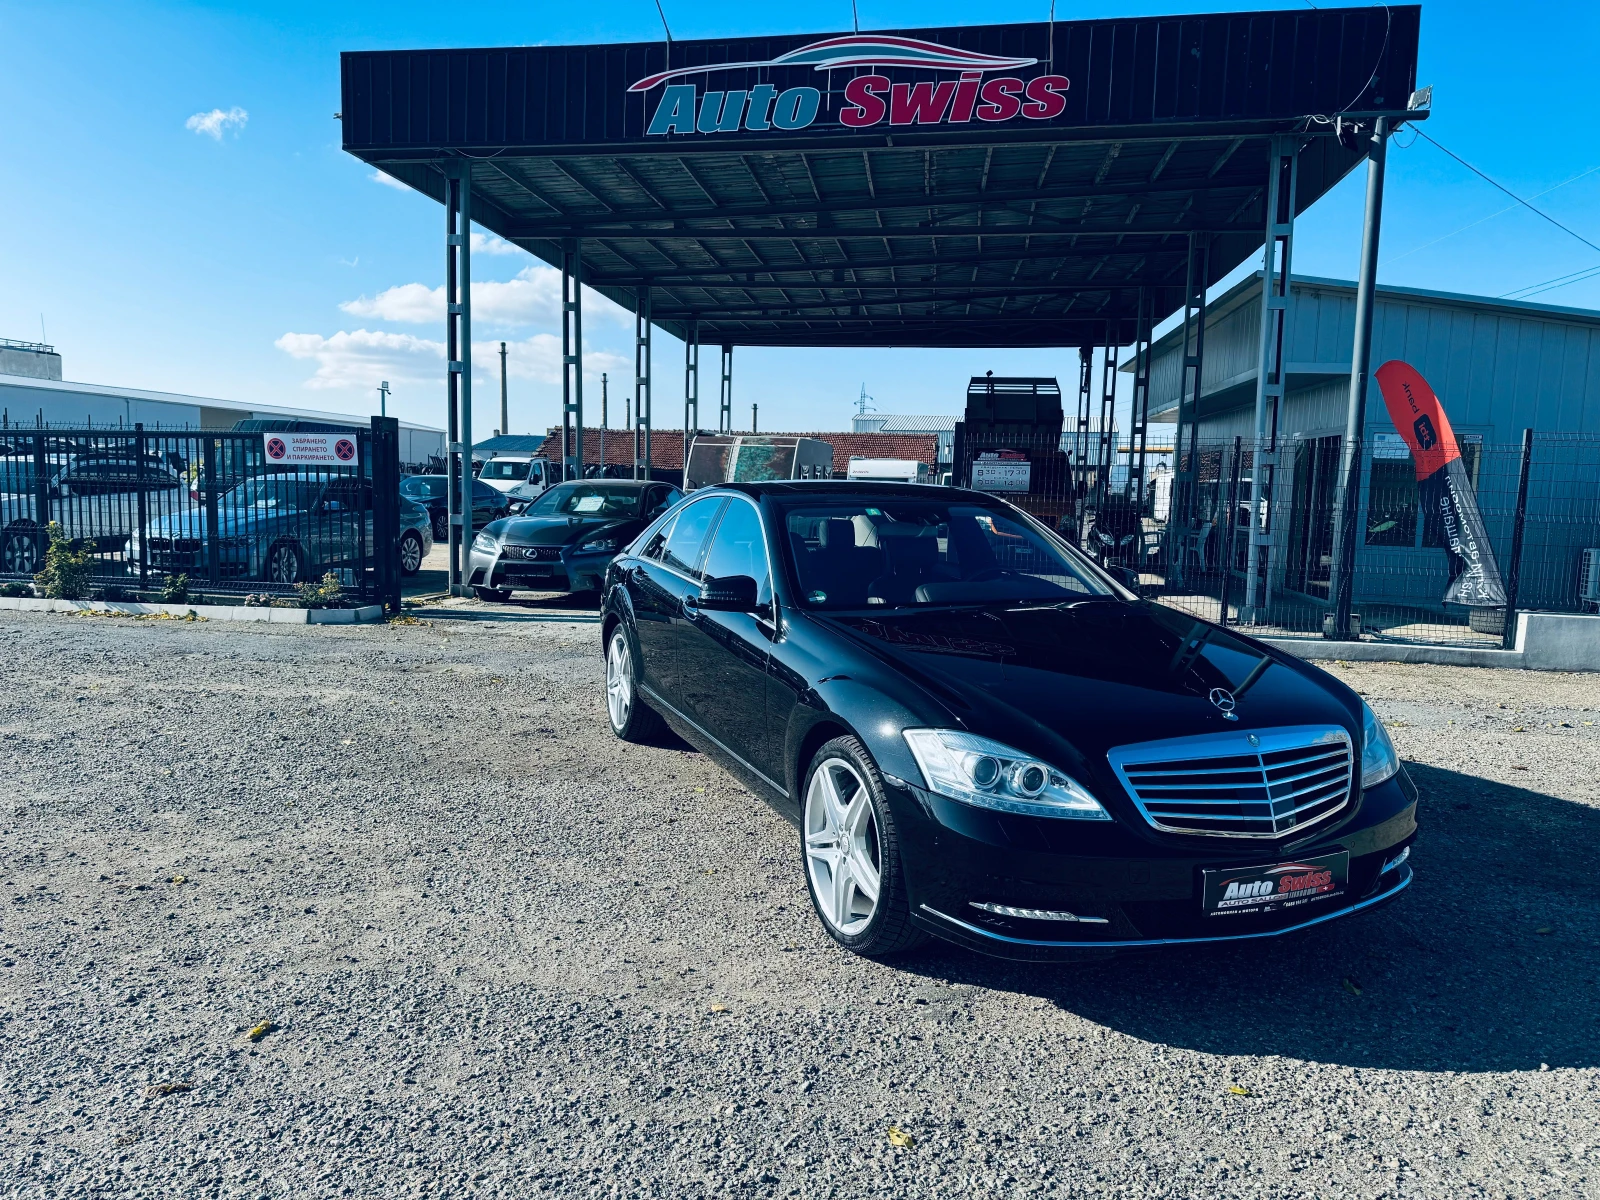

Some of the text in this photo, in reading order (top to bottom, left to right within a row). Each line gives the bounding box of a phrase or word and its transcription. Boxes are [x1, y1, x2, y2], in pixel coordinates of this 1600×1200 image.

[646, 71, 1070, 135] Auto Swiss
[1223, 870, 1332, 900] Auto Swiss
[1221, 898, 1250, 907] AUTO
